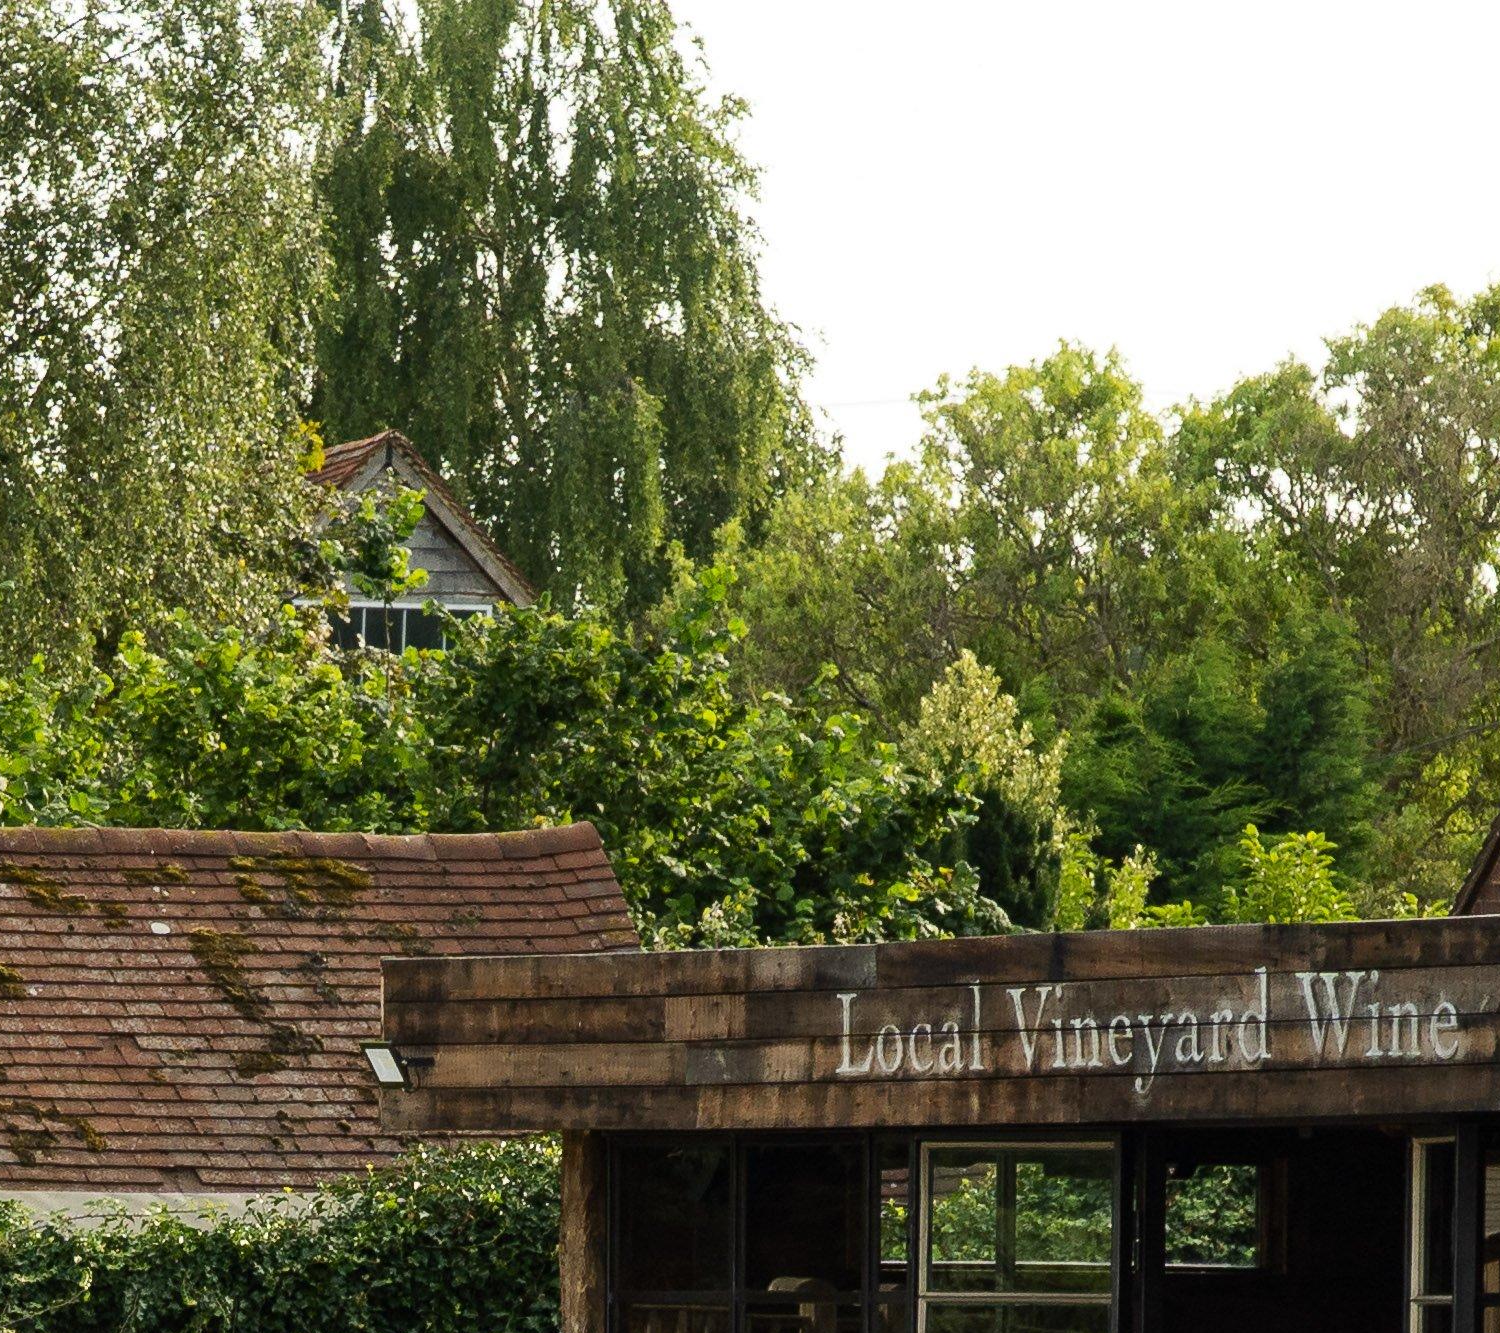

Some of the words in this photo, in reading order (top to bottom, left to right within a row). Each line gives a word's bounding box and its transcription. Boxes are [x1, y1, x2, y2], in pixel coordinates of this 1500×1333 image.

[836, 978, 986, 1076] Local
[1006, 965, 1272, 1094] Vineyard
[1294, 968, 1462, 1061] Wine
